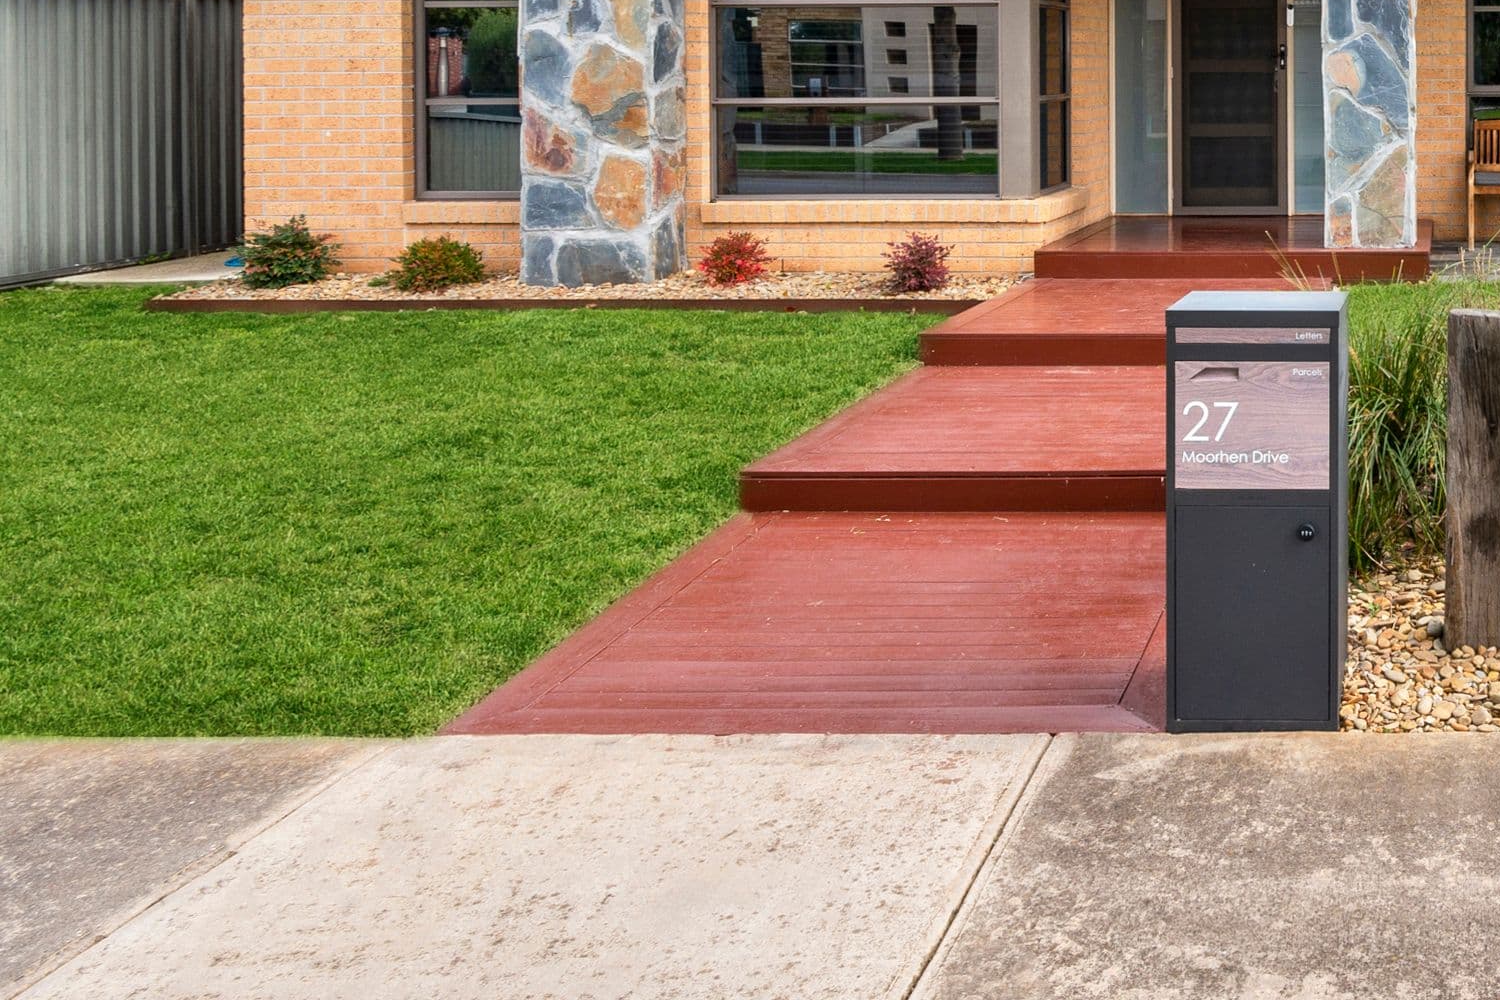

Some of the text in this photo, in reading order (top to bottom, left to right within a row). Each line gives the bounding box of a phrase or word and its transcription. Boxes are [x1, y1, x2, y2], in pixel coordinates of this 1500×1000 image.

[1295, 331, 1323, 340] Letters
[1292, 367, 1322, 376] Parcels
[1182, 400, 1239, 442] 27
[1182, 450, 1289, 464] Moorhen Drive
